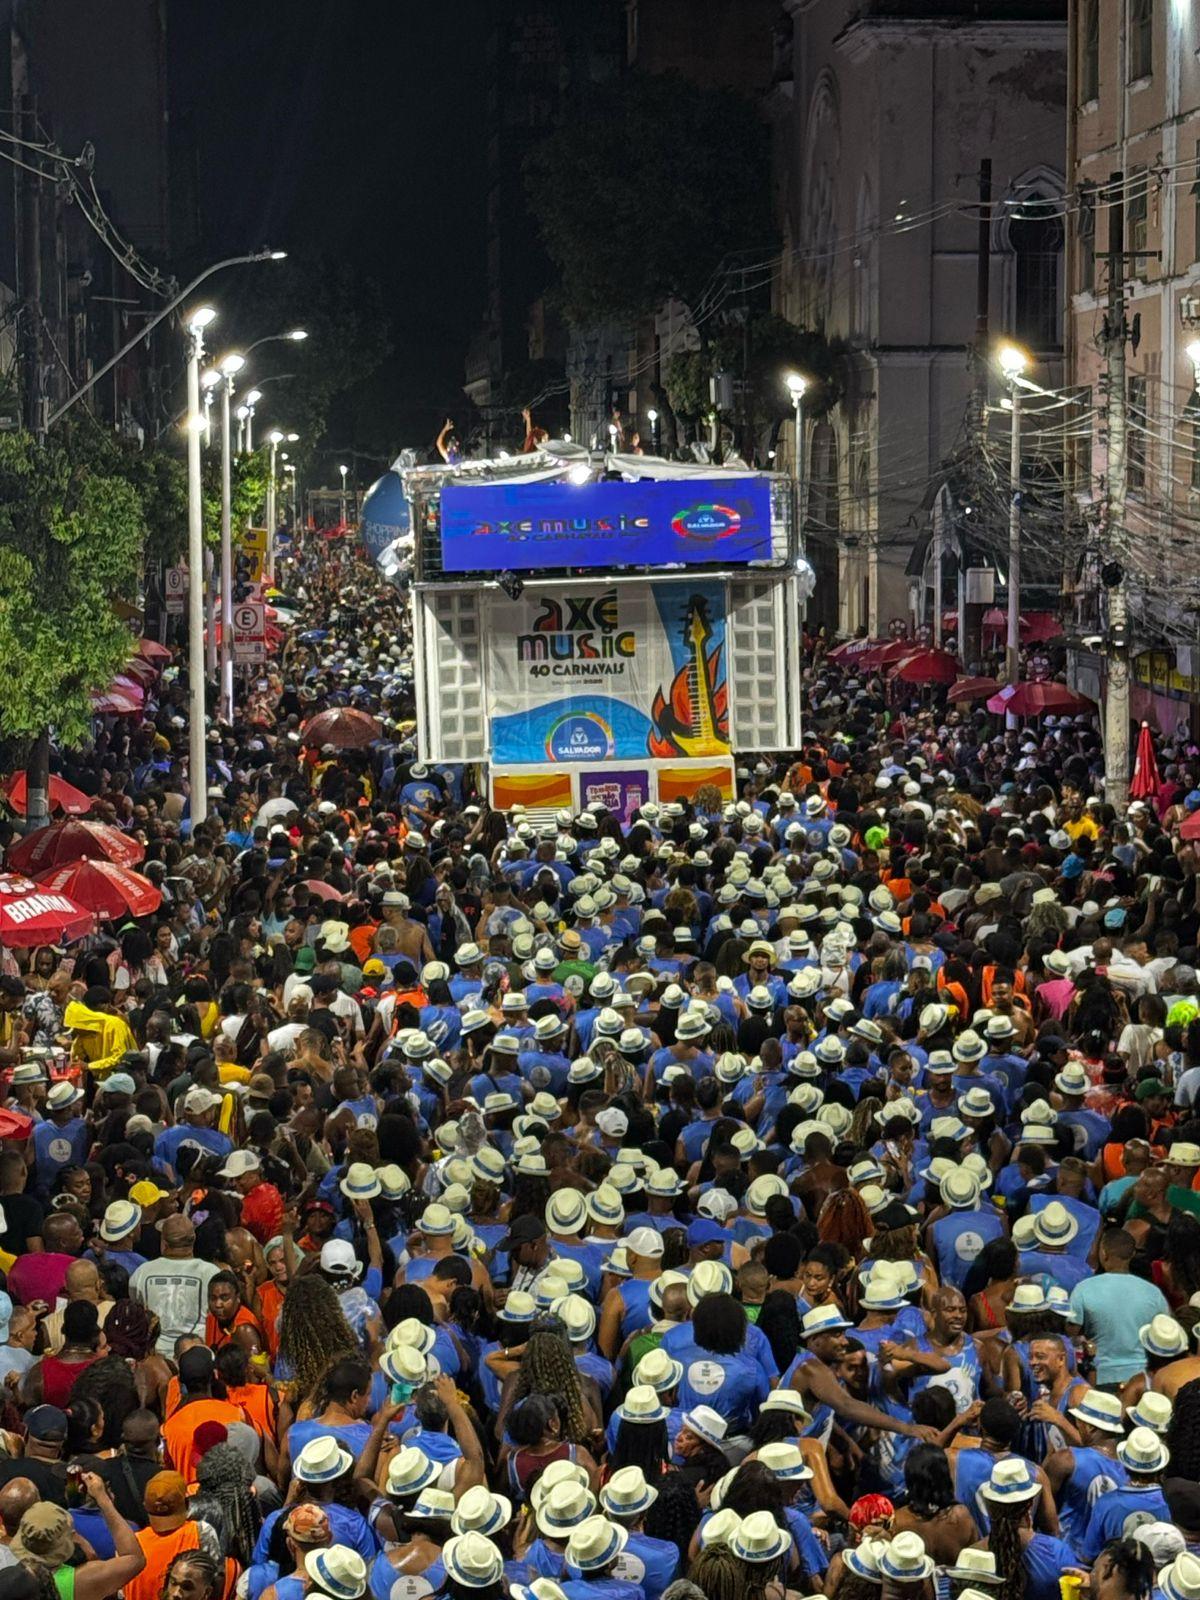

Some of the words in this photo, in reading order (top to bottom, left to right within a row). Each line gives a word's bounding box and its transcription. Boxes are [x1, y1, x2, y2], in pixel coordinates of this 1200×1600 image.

[241, 611, 251, 626] E
[533, 588, 618, 632] axé
[517, 627, 636, 661] music
[530, 664, 550, 678] 40
[552, 663, 625, 676] CARNAVAIS
[558, 746, 602, 755] SALVADOR
[2, 893, 78, 924] BRAHMA
